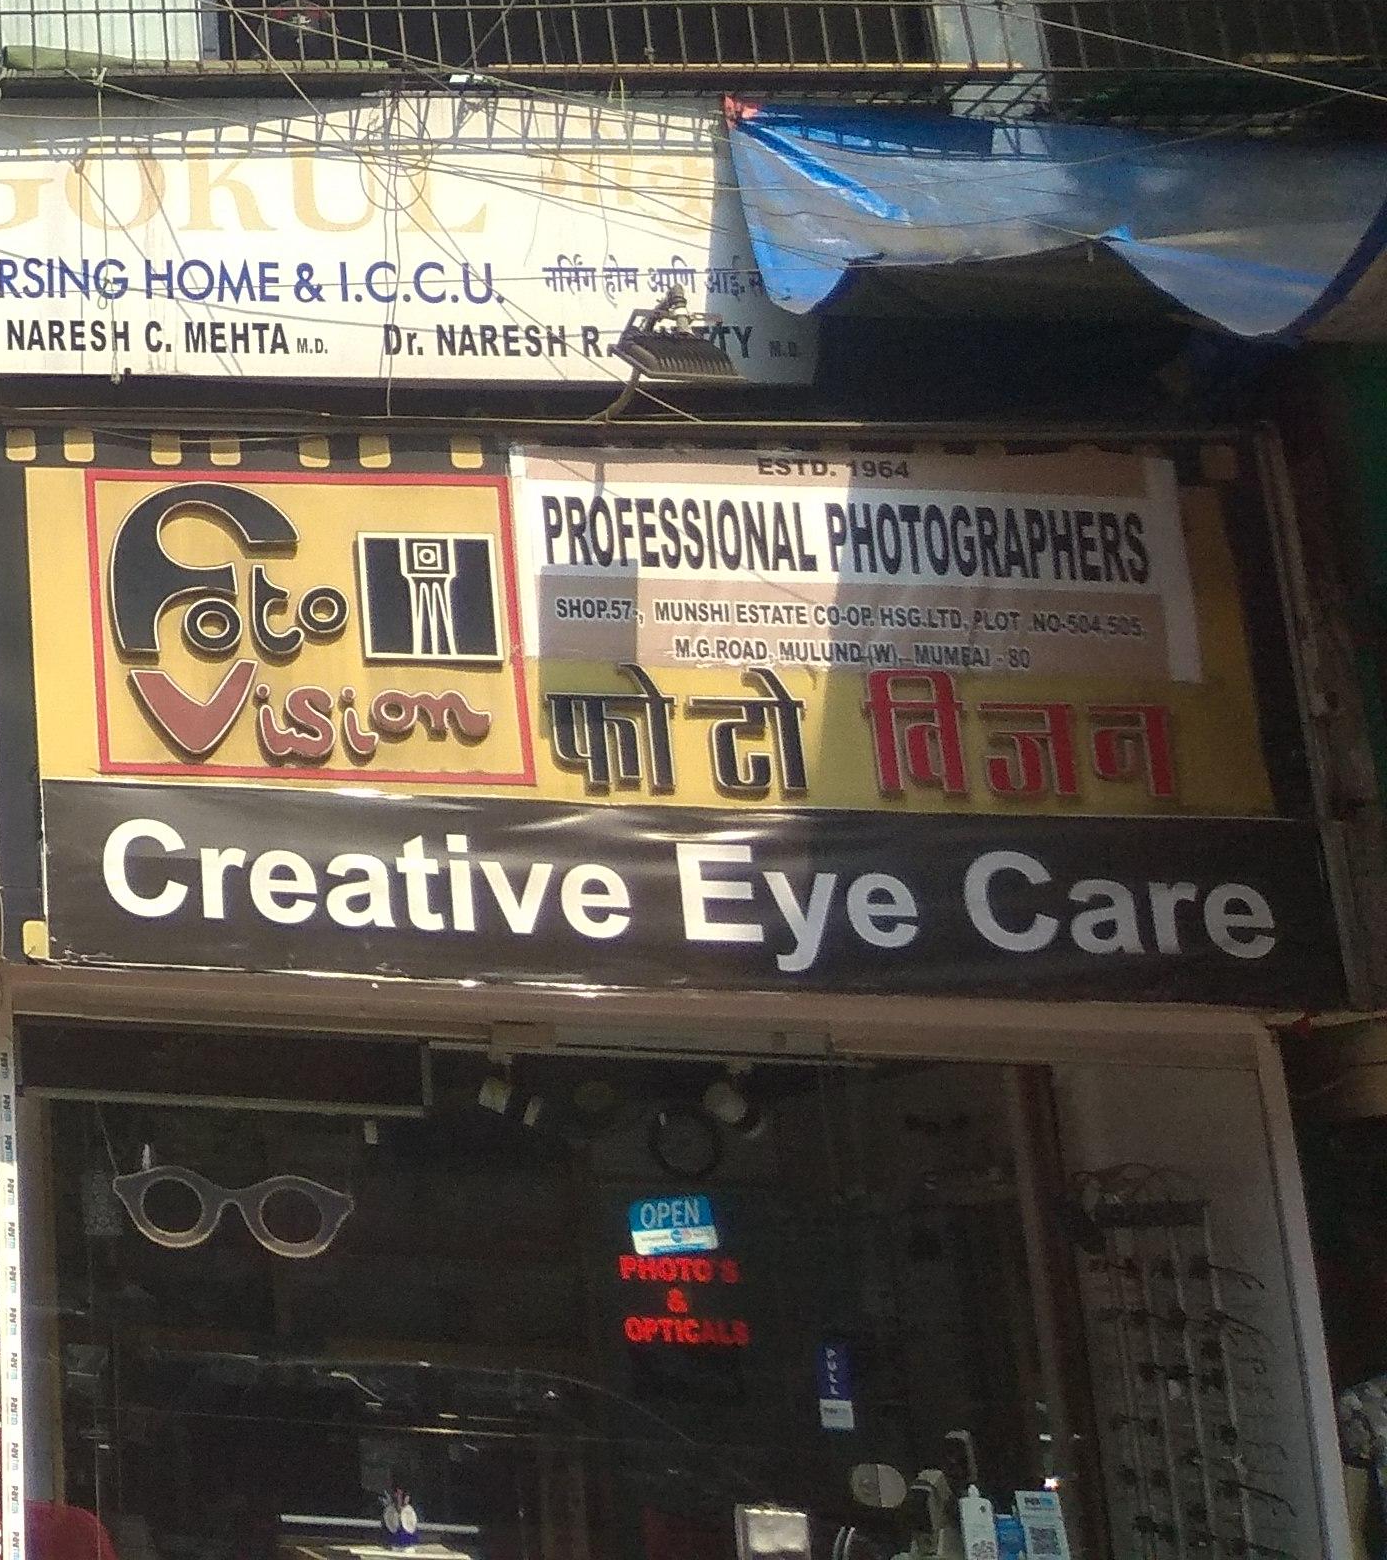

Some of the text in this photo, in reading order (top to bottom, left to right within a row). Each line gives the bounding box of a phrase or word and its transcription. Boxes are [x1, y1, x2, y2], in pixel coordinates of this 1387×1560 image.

[144, 260, 280, 303] HOME
[293, 263, 324, 303] &
[340, 261, 505, 303] I.C.C.U.
[6, 319, 130, 353] NARESH
[184, 321, 291, 354] MEHTA
[437, 324, 568, 357] NARESH
[757, 458, 910, 478] ESTD. 1964
[542, 496, 1150, 584] PROFESSIONAL PHOTOGRAPHERS
[110, 482, 350, 653] Foto
[655, 601, 808, 625] MUNSHI ESTATE
[130, 659, 492, 756] Vision
[101, 817, 1278, 973] Creative Eye Care
[640, 1199, 699, 1229] OPEN
